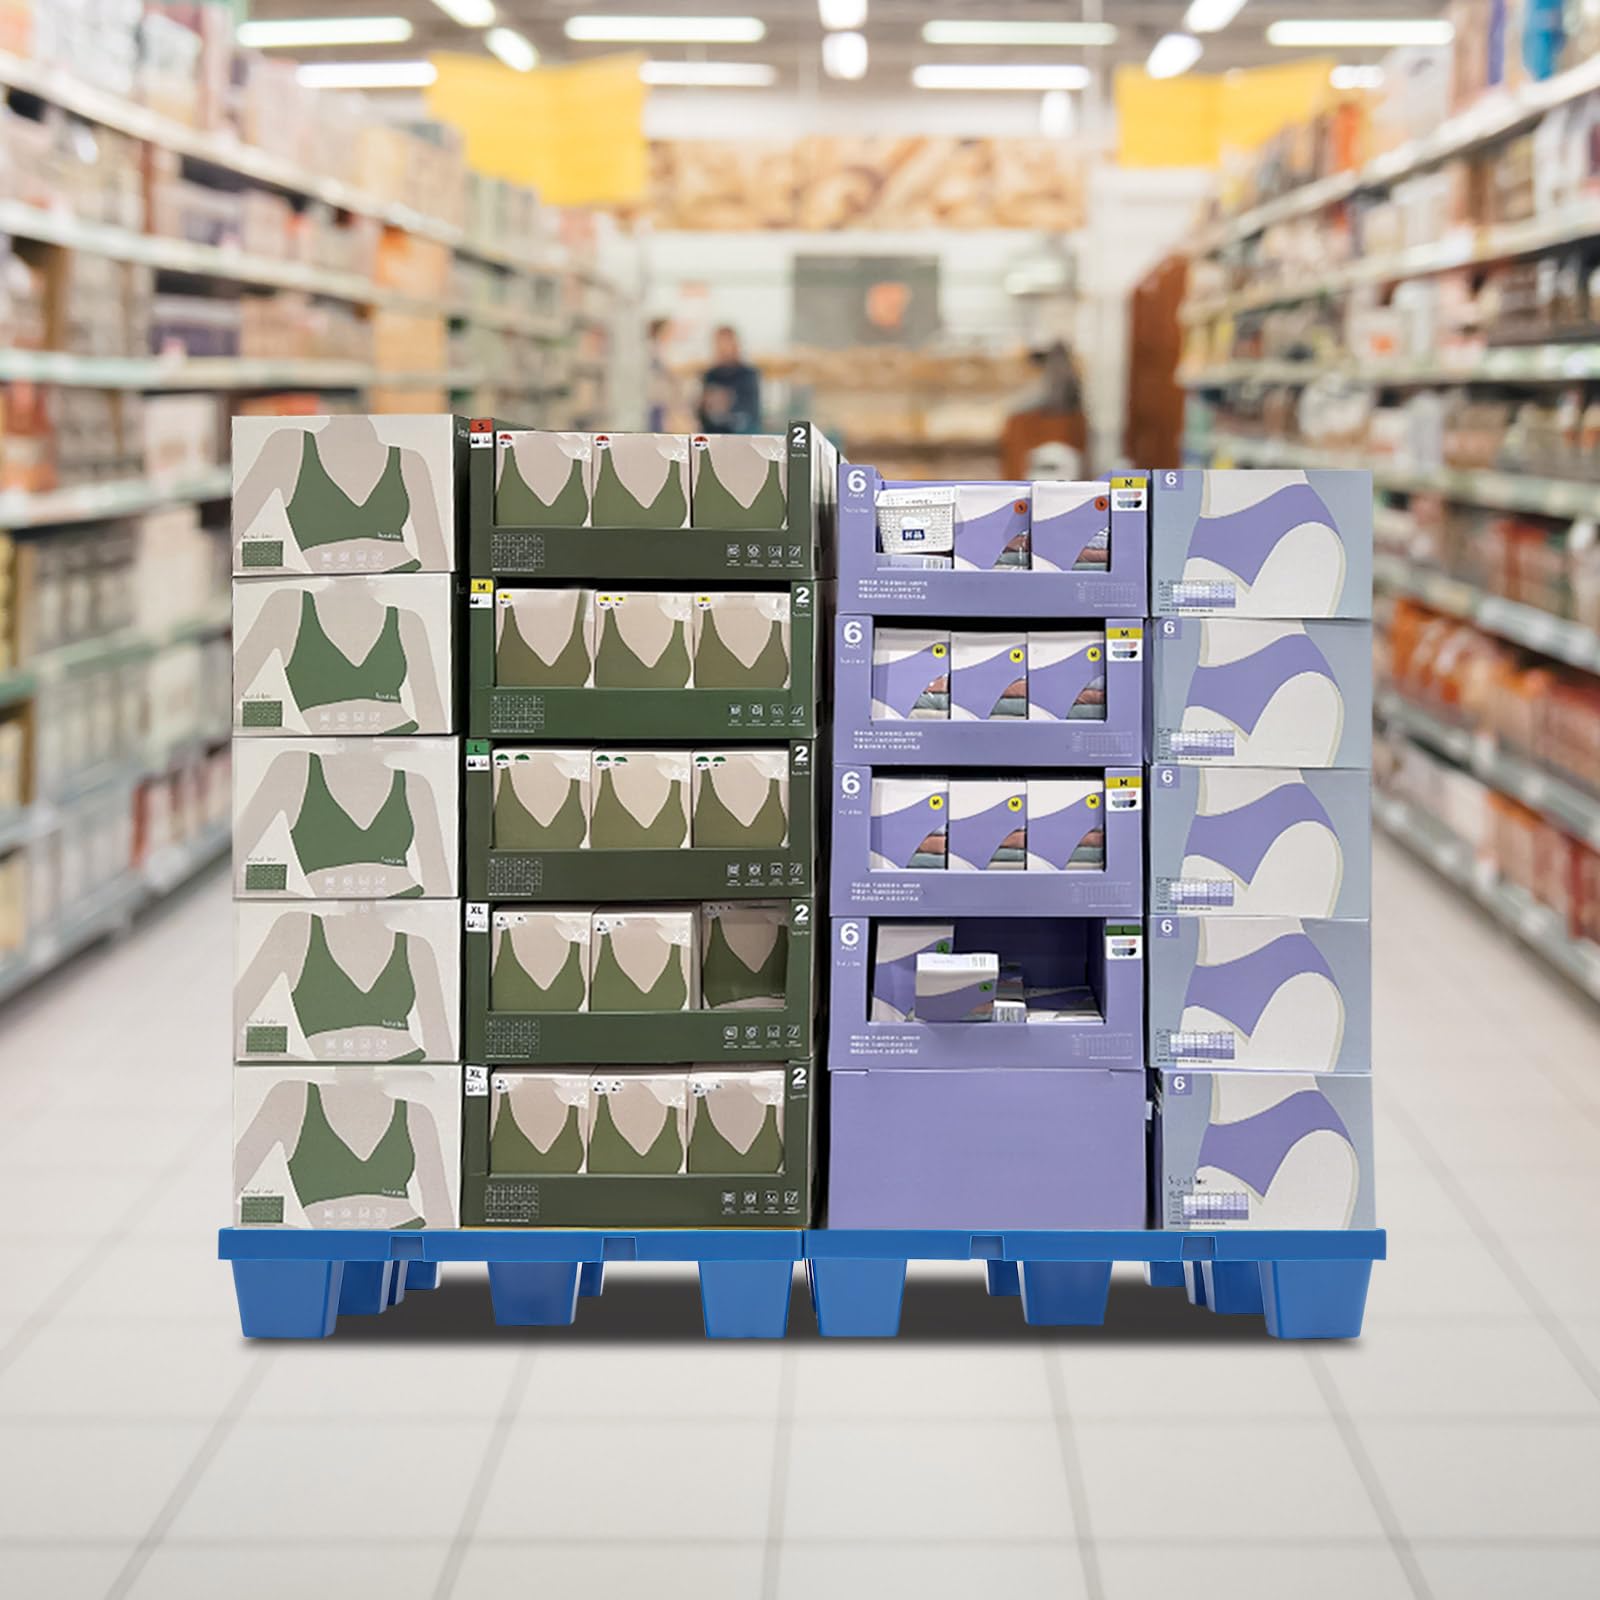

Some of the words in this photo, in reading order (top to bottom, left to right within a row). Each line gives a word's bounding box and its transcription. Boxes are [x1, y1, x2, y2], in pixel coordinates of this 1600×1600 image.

[792, 427, 807, 444] 2
[847, 470, 867, 493] 6
[1165, 471, 1176, 485] 6
[795, 587, 810, 604] 2
[844, 621, 863, 644] 6
[1163, 621, 1175, 634] 6
[474, 744, 480, 752] L
[795, 746, 809, 762] 2
[841, 771, 860, 795] 6
[1162, 770, 1173, 783] 6
[471, 906, 483, 914] XL
[794, 904, 809, 921] 2
[1161, 919, 1172, 933] 6
[840, 922, 859, 947] 6
[470, 1068, 482, 1079] XL
[792, 1067, 807, 1085] 2
[1173, 1076, 1185, 1090] 6
